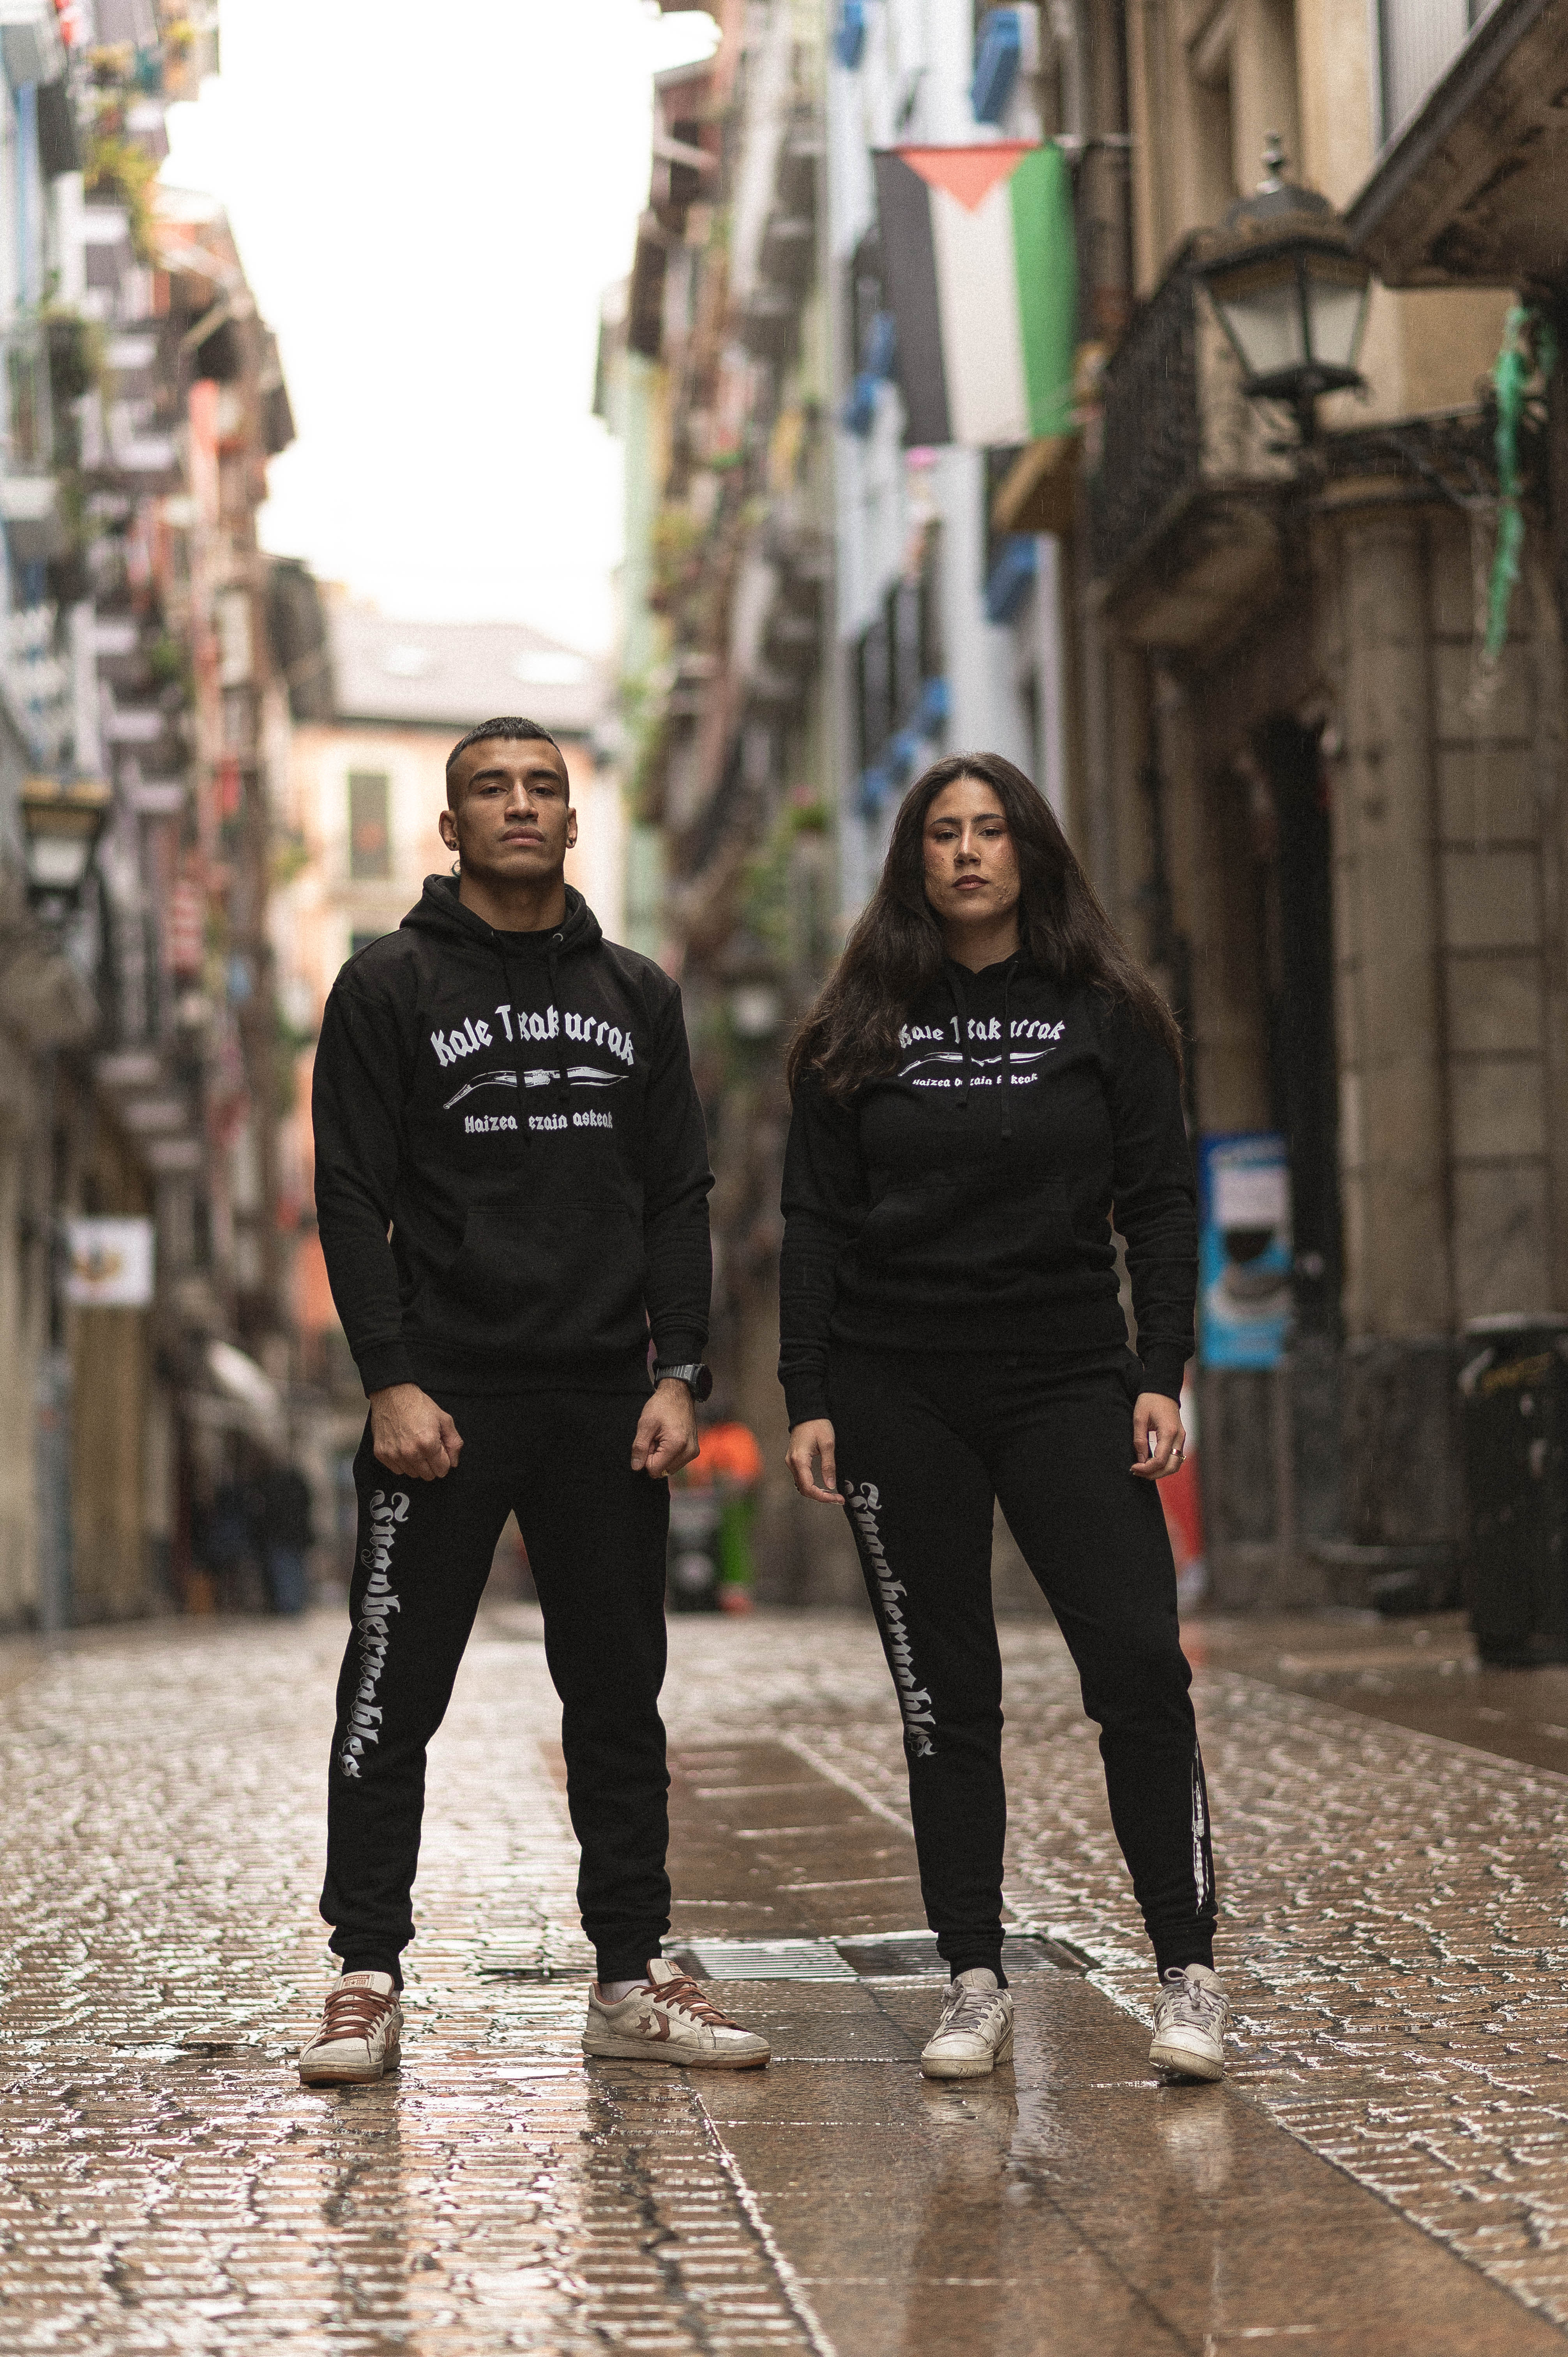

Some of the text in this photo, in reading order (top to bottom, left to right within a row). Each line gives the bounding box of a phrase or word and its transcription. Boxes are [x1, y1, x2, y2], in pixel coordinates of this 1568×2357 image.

[430, 1017, 493, 1067] Kale
[464, 1109, 613, 1133] Haizea ezain askeak
